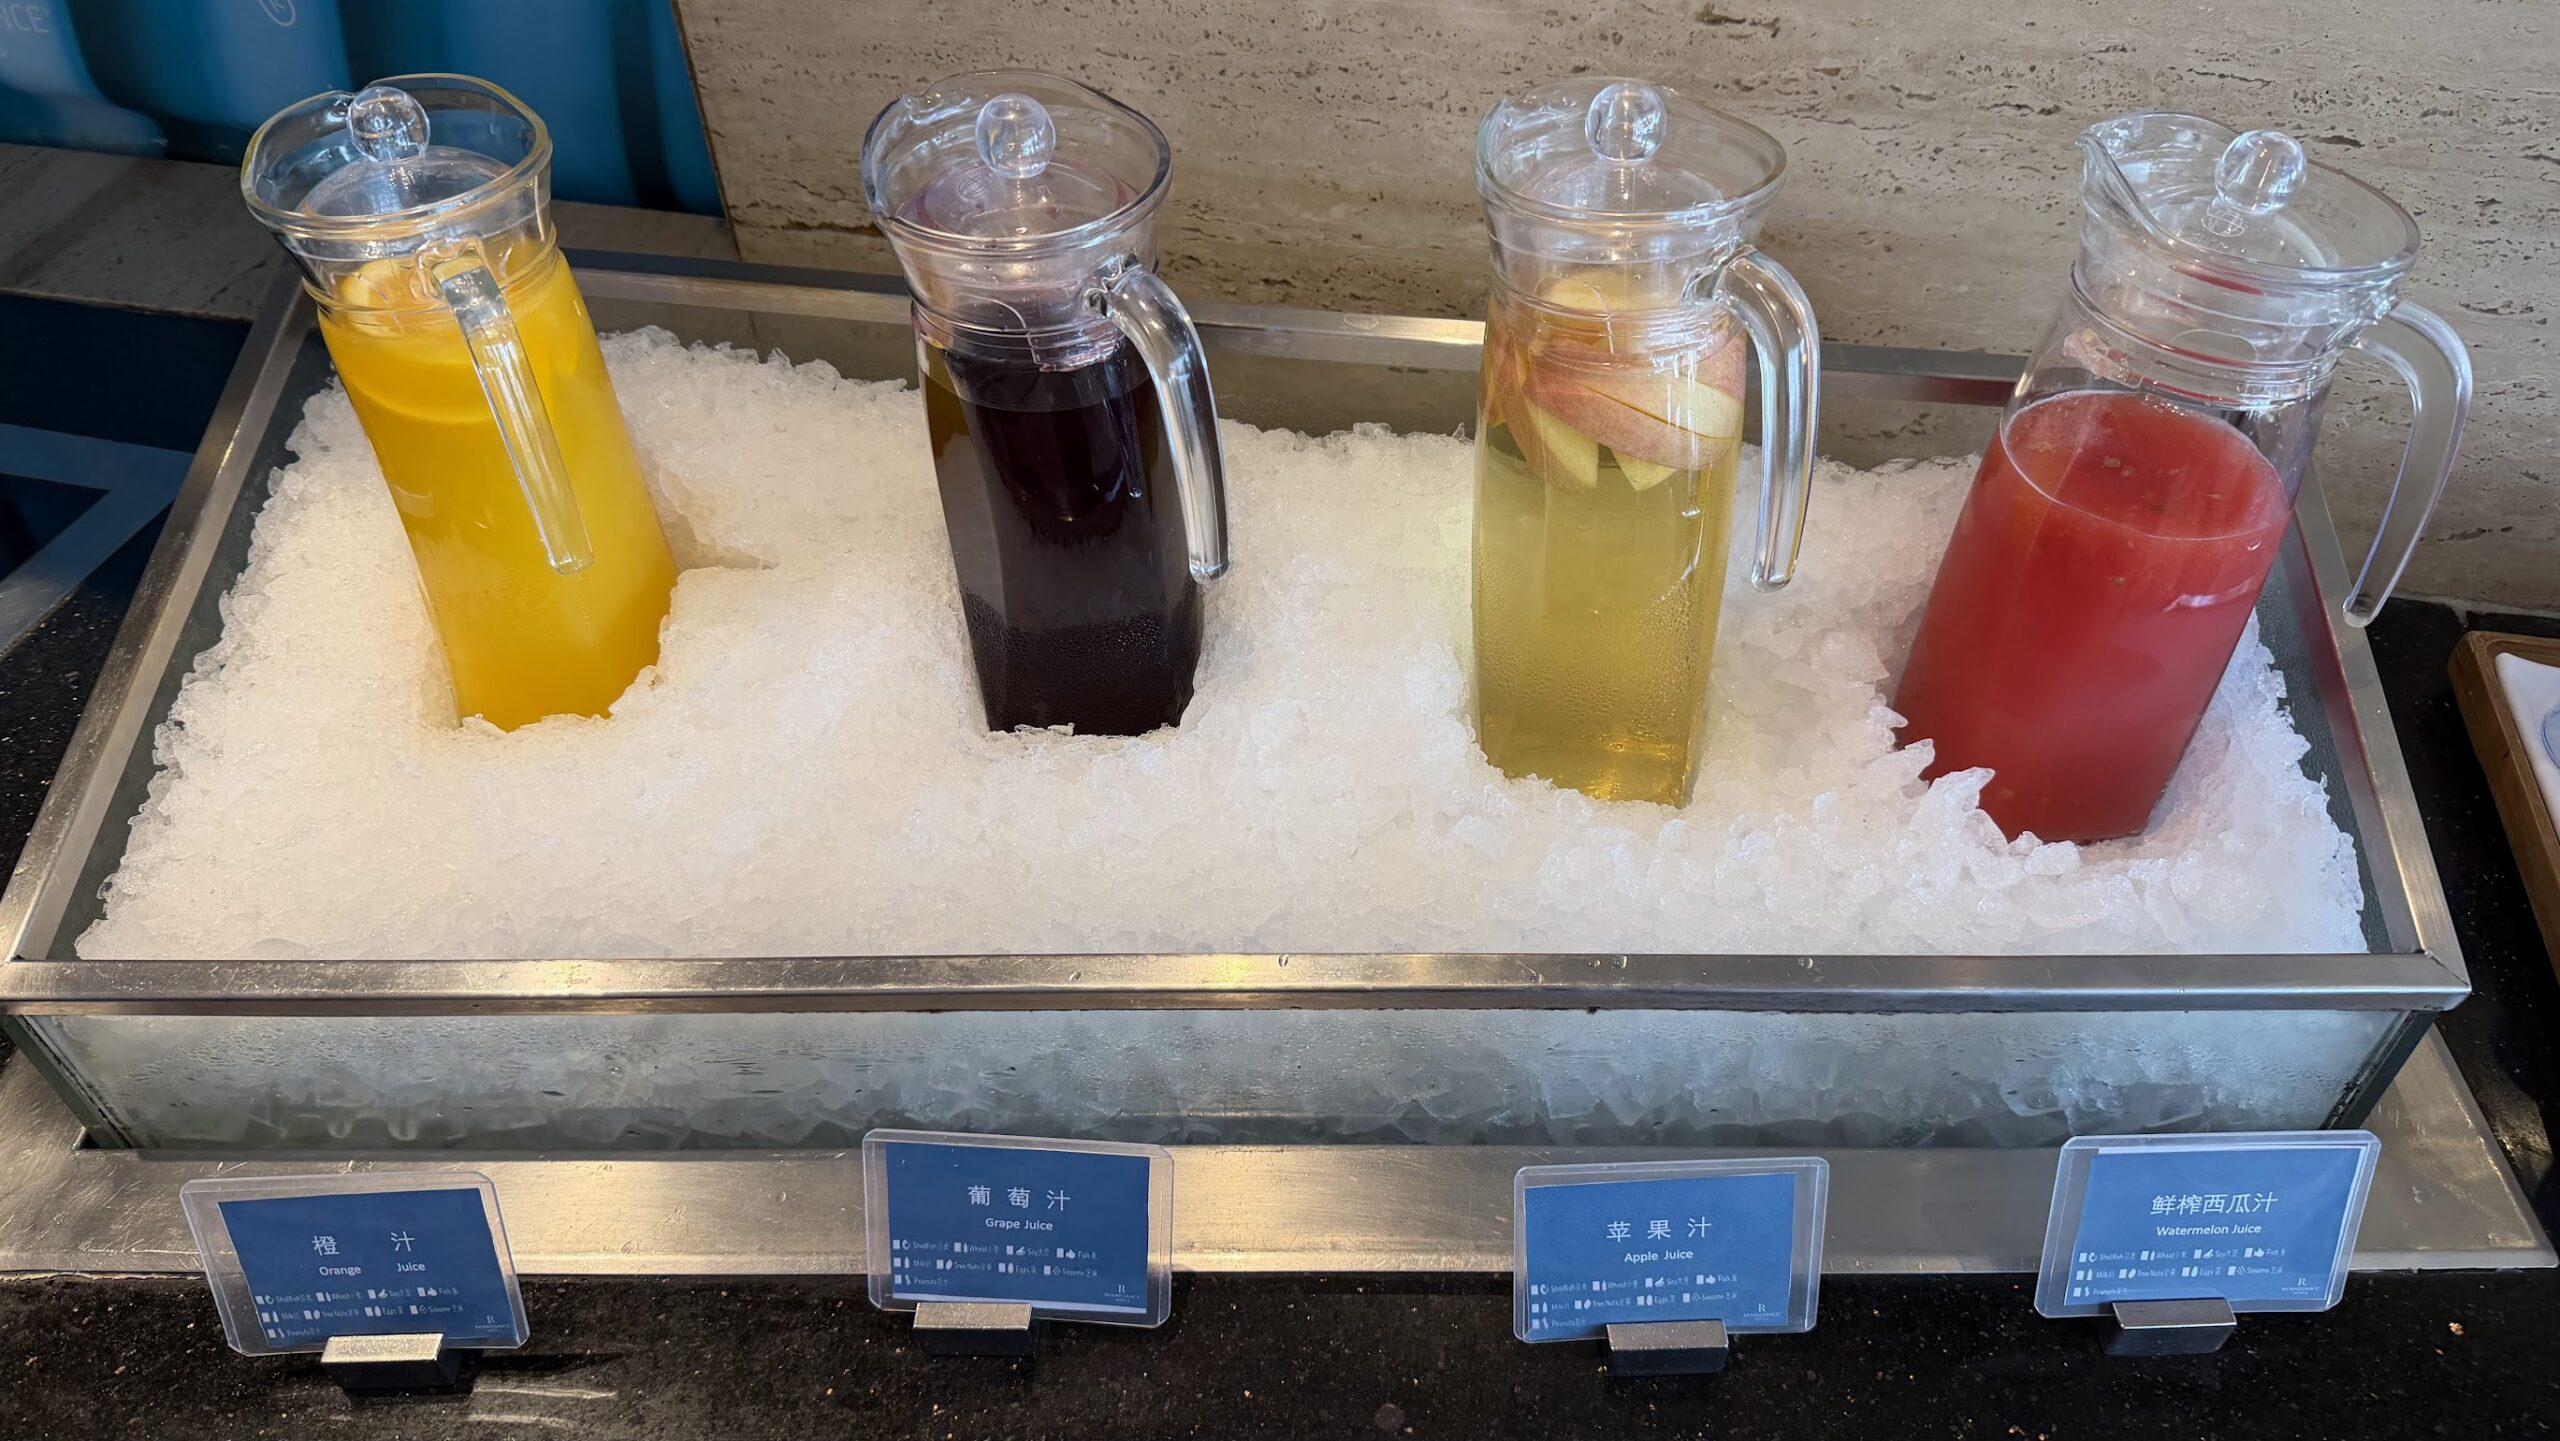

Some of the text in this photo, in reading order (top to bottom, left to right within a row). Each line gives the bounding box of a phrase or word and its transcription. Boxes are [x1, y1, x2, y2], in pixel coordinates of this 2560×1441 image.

[968, 1185, 1071, 1211] 葡萄汁
[2150, 1192, 2278, 1216] 鲜榨西瓜汁
[985, 1217, 1054, 1230] Grape Juice
[1606, 1216, 1712, 1242] 苹果汁
[2157, 1224, 2262, 1236] Watermelon Juice
[1624, 1250, 1694, 1264] Apple Juice
[319, 1262, 425, 1276] Orange Juice
